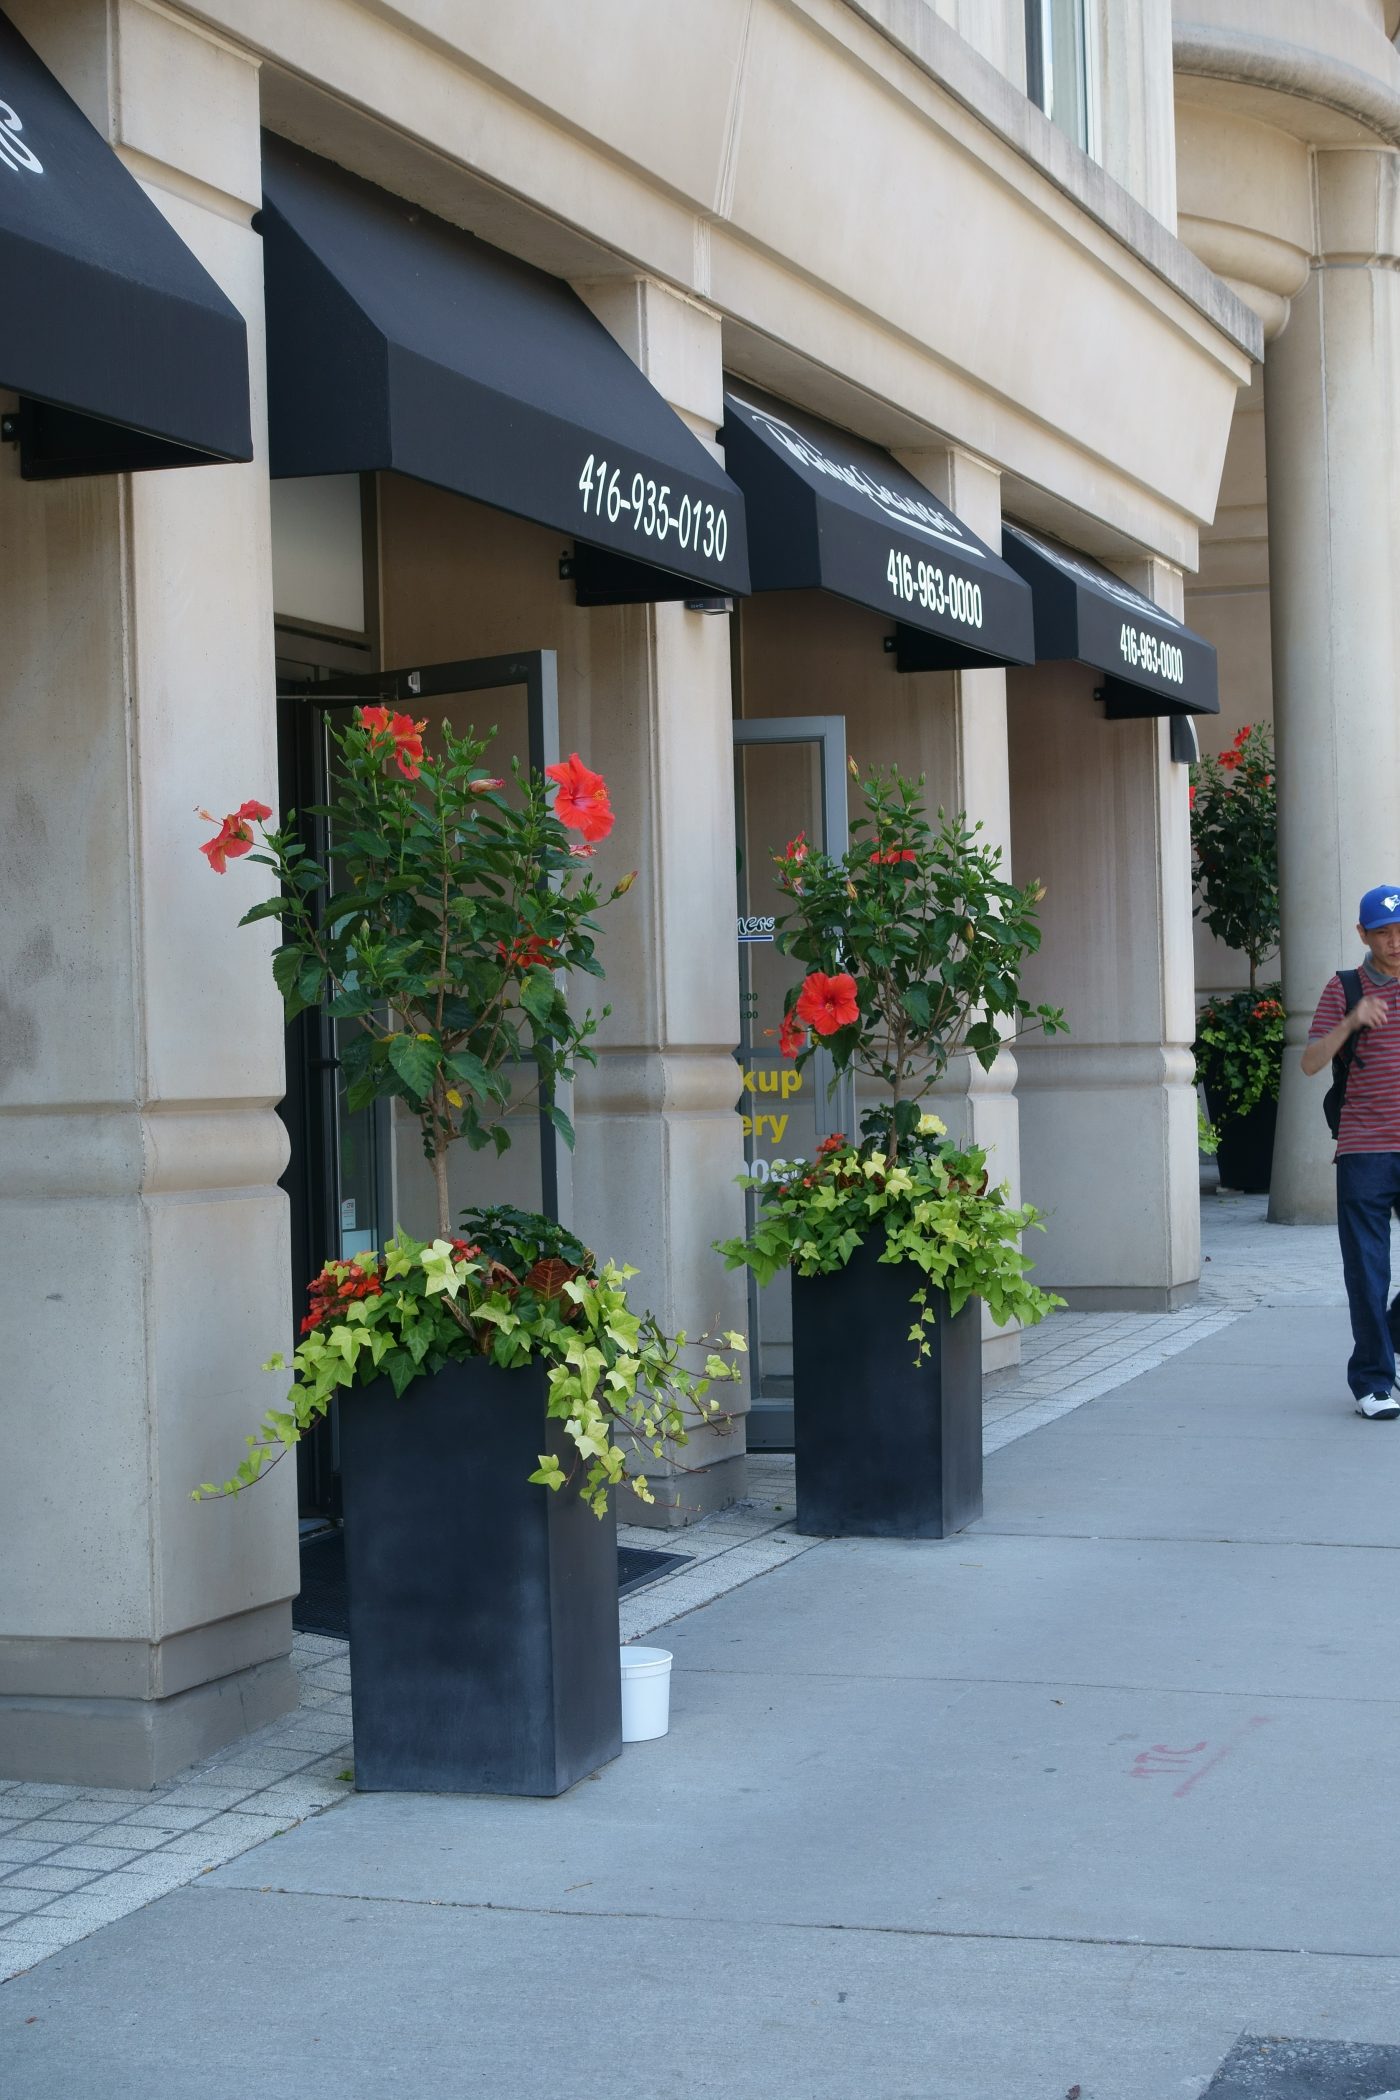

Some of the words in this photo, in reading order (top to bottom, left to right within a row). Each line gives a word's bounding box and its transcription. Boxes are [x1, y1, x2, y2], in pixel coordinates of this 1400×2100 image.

[579, 454, 728, 562] 416-935-0130
[887, 548, 983, 629] 416-963-0000
[1120, 623, 1184, 685] 416-963-0000
